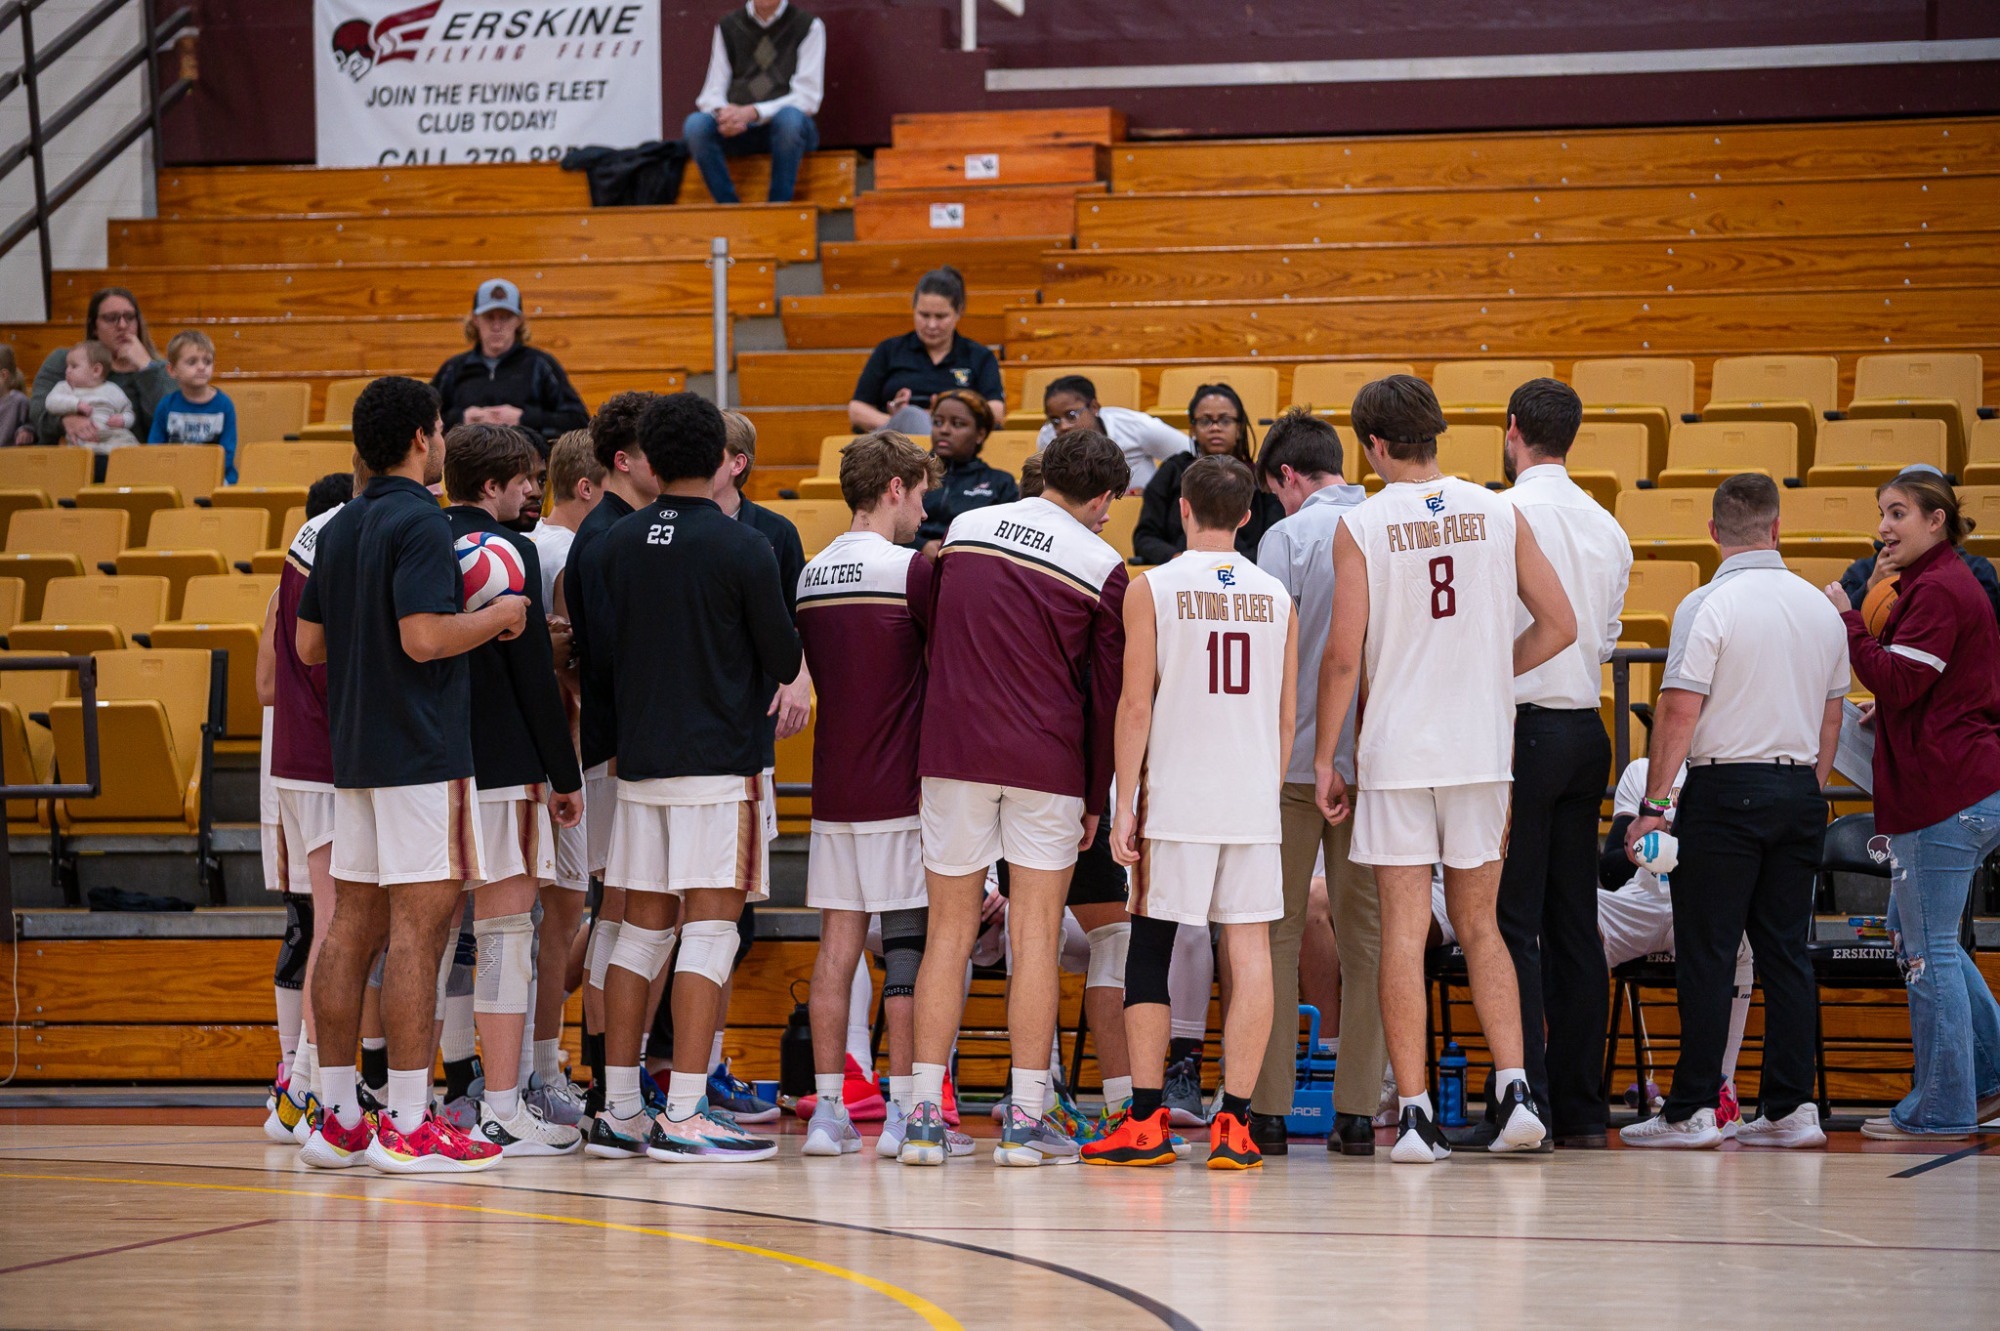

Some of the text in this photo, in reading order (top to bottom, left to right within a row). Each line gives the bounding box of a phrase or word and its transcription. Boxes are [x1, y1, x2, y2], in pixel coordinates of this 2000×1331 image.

[442, 5, 643, 41] ERSKINE
[425, 40, 643, 62] FLYING FLEET
[366, 79, 609, 108] JOIN THE FLYING FLEET
[418, 109, 557, 134] CLUB TODAY!
[647, 524, 675, 545] 23
[994, 520, 1054, 553] RIVERA
[1386, 513, 1487, 552] FLYING FLEET
[804, 562, 864, 588] WALTERS
[1428, 555, 1456, 620] 8
[1176, 591, 1274, 623] FLYING FLEET
[1206, 631, 1250, 695] 10
[1832, 948, 1895, 960] ERSKINE
